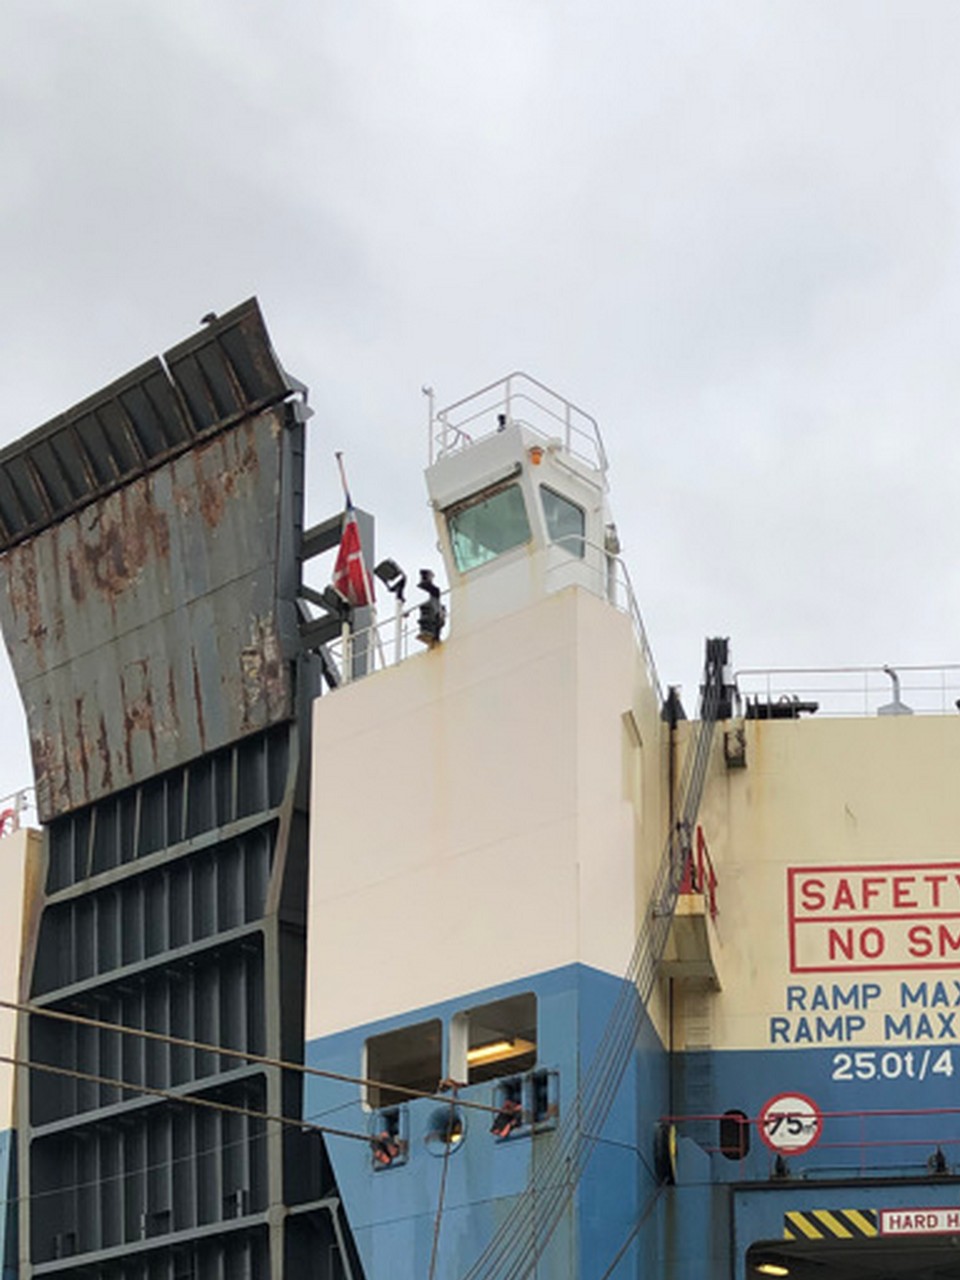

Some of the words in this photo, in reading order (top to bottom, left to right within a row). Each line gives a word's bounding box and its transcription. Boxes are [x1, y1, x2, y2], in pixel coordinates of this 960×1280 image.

[827, 927, 886, 961] NO
[786, 983, 882, 1011] RAMP
[770, 1014, 866, 1043] RAMP
[883, 1012, 957, 1040] MAX
[889, 1213, 939, 1230] HARD
